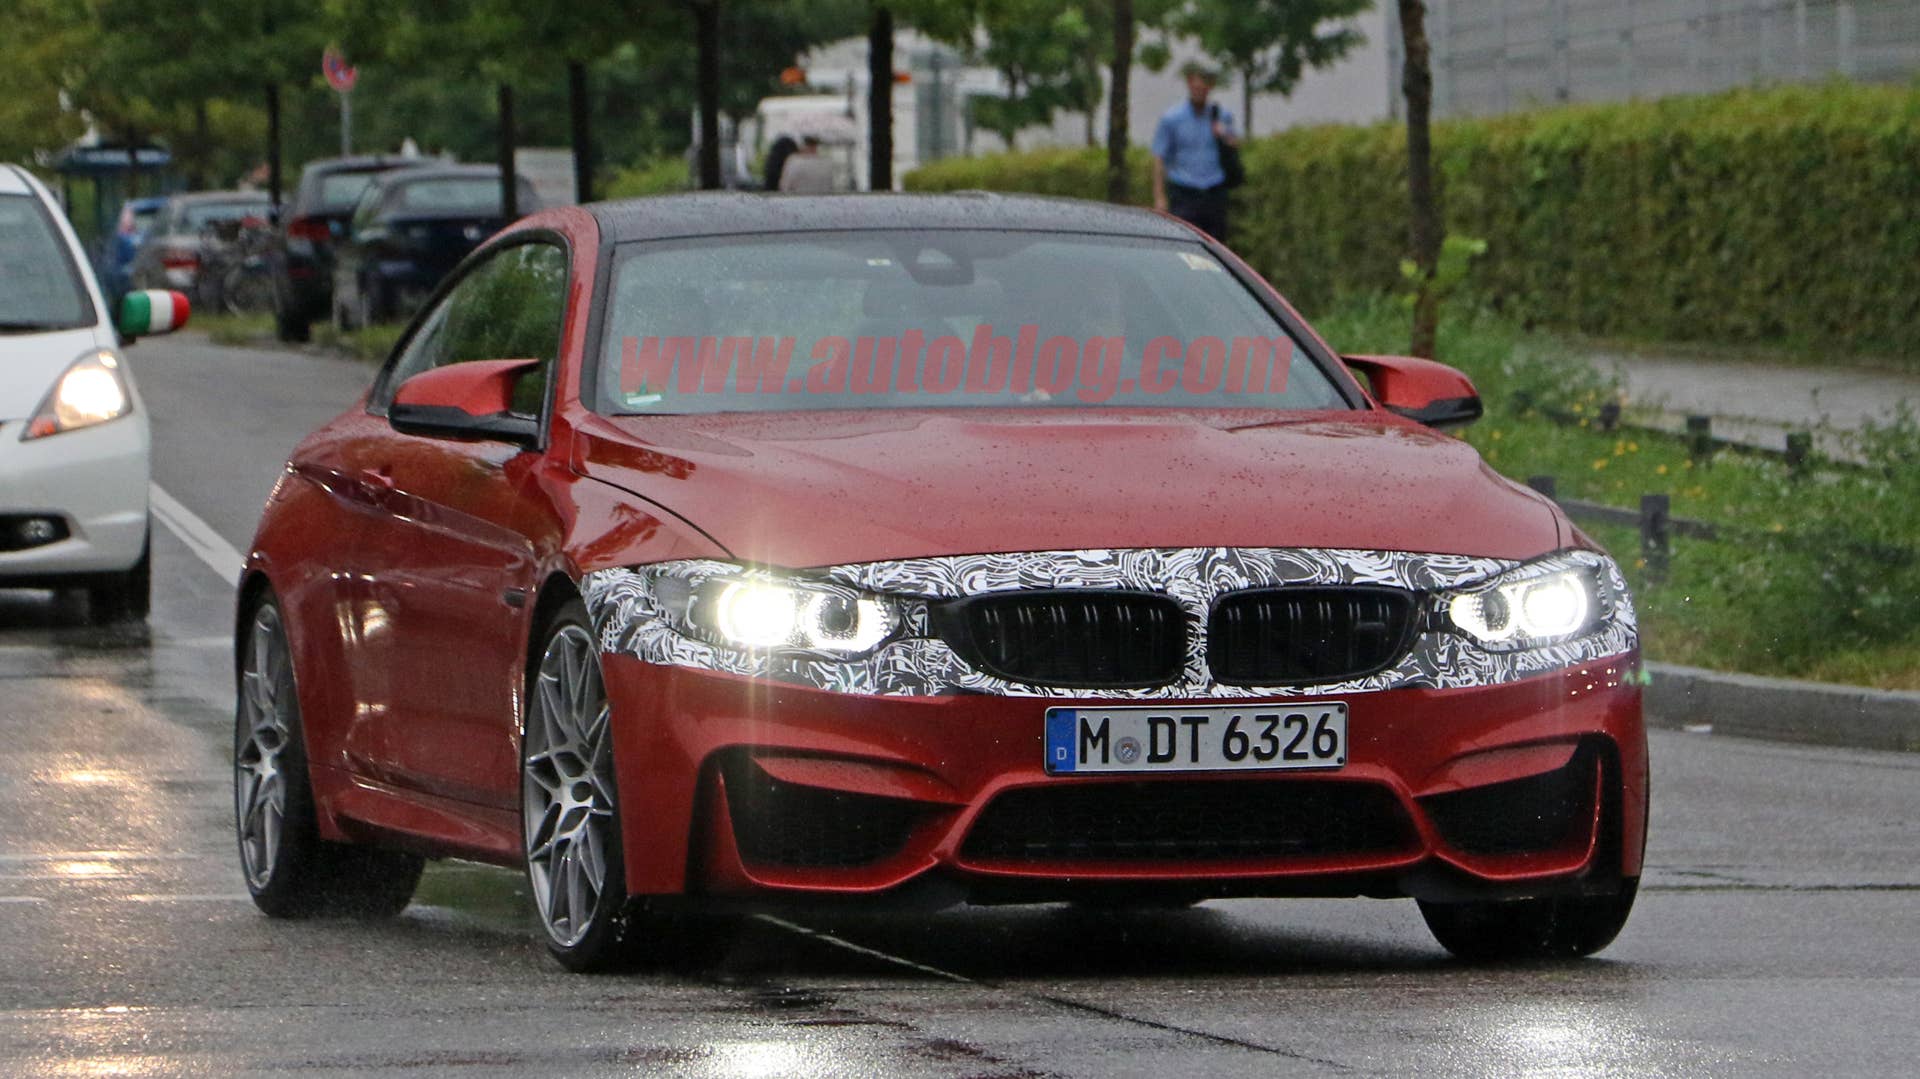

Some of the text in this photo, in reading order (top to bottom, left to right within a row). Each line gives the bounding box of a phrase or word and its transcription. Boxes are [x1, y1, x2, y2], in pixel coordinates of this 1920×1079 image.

[1056, 747, 1067, 761] D
[1079, 713, 1339, 764] M DT 6326
